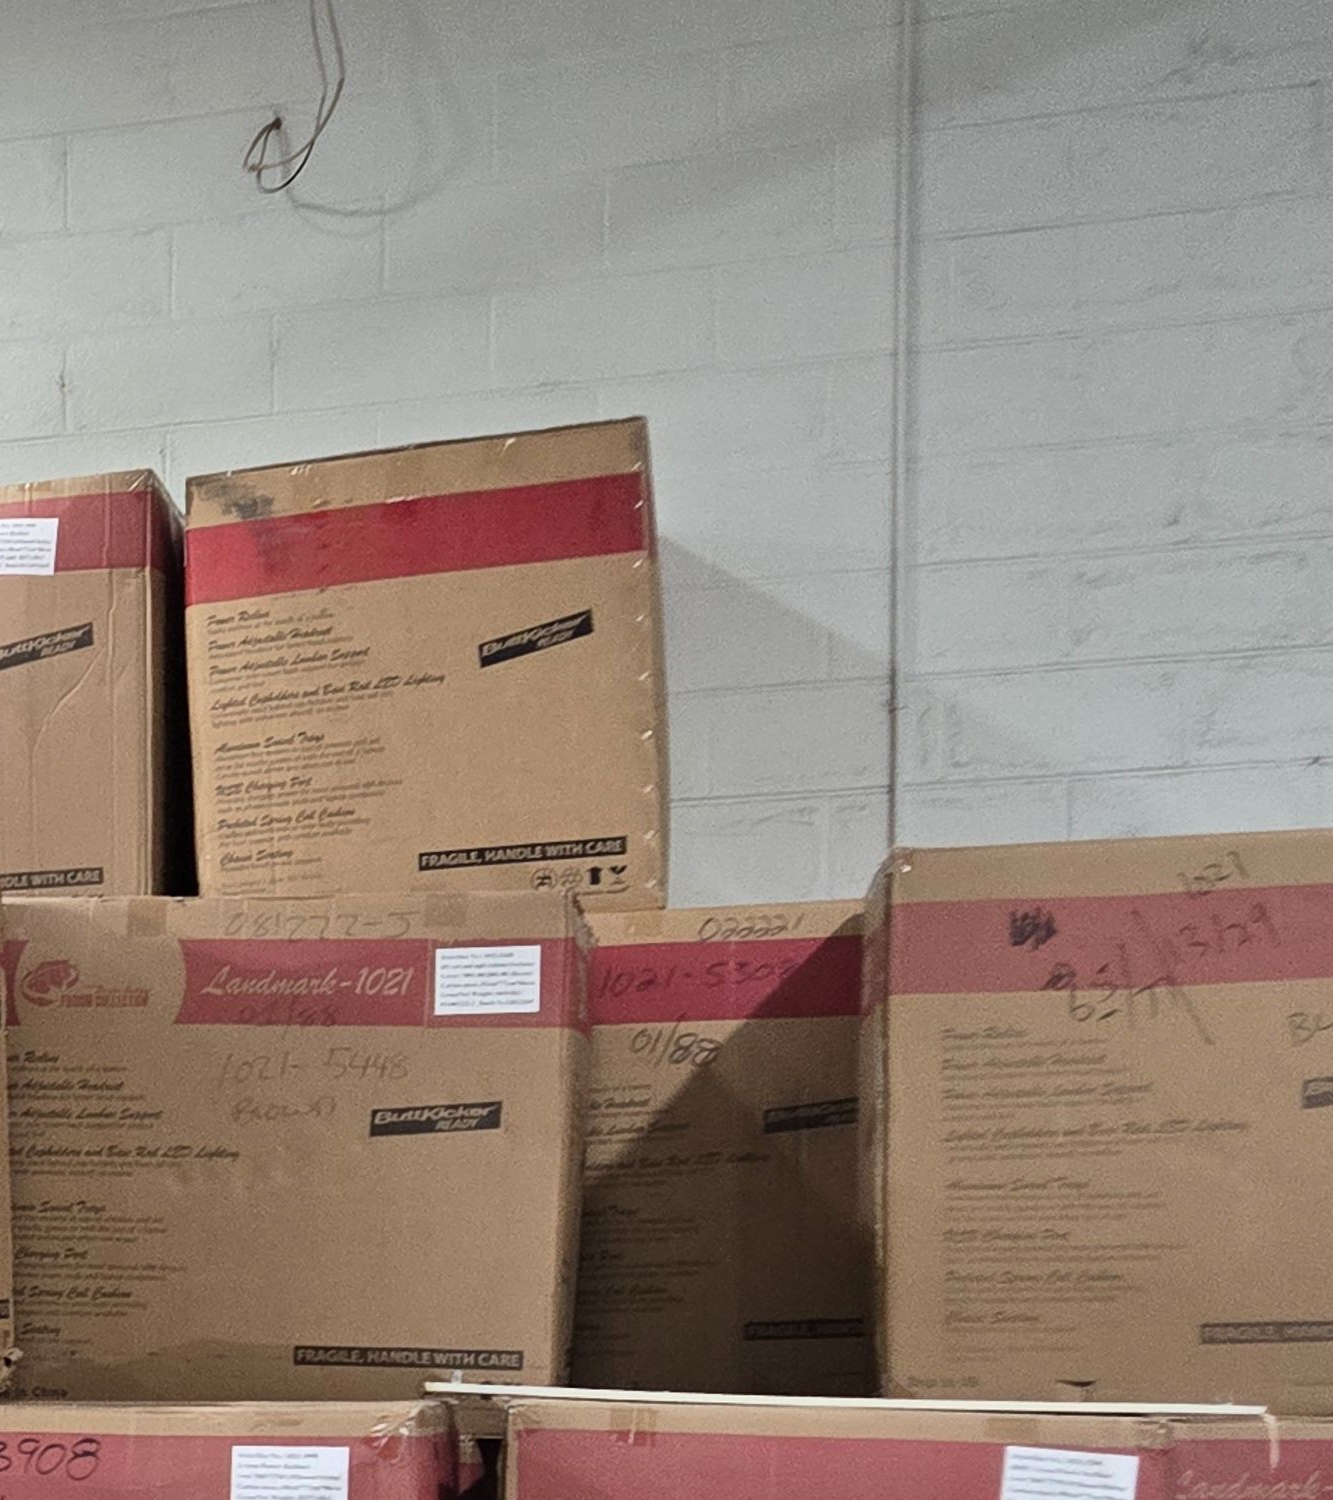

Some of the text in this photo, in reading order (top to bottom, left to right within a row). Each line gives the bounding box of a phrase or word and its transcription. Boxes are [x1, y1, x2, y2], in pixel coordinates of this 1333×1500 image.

[40, 640, 77, 658] READY
[421, 839, 623, 868] FRAGILE, HANDLE WITH CARE
[34, 869, 100, 886] WITH CARE
[200, 964, 414, 998] Landmark-1021
[374, 1102, 500, 1125] ButtKicker
[434, 1117, 480, 1131] READY
[296, 1346, 520, 1367] FRAGILE, HANDLE WITH CARE
